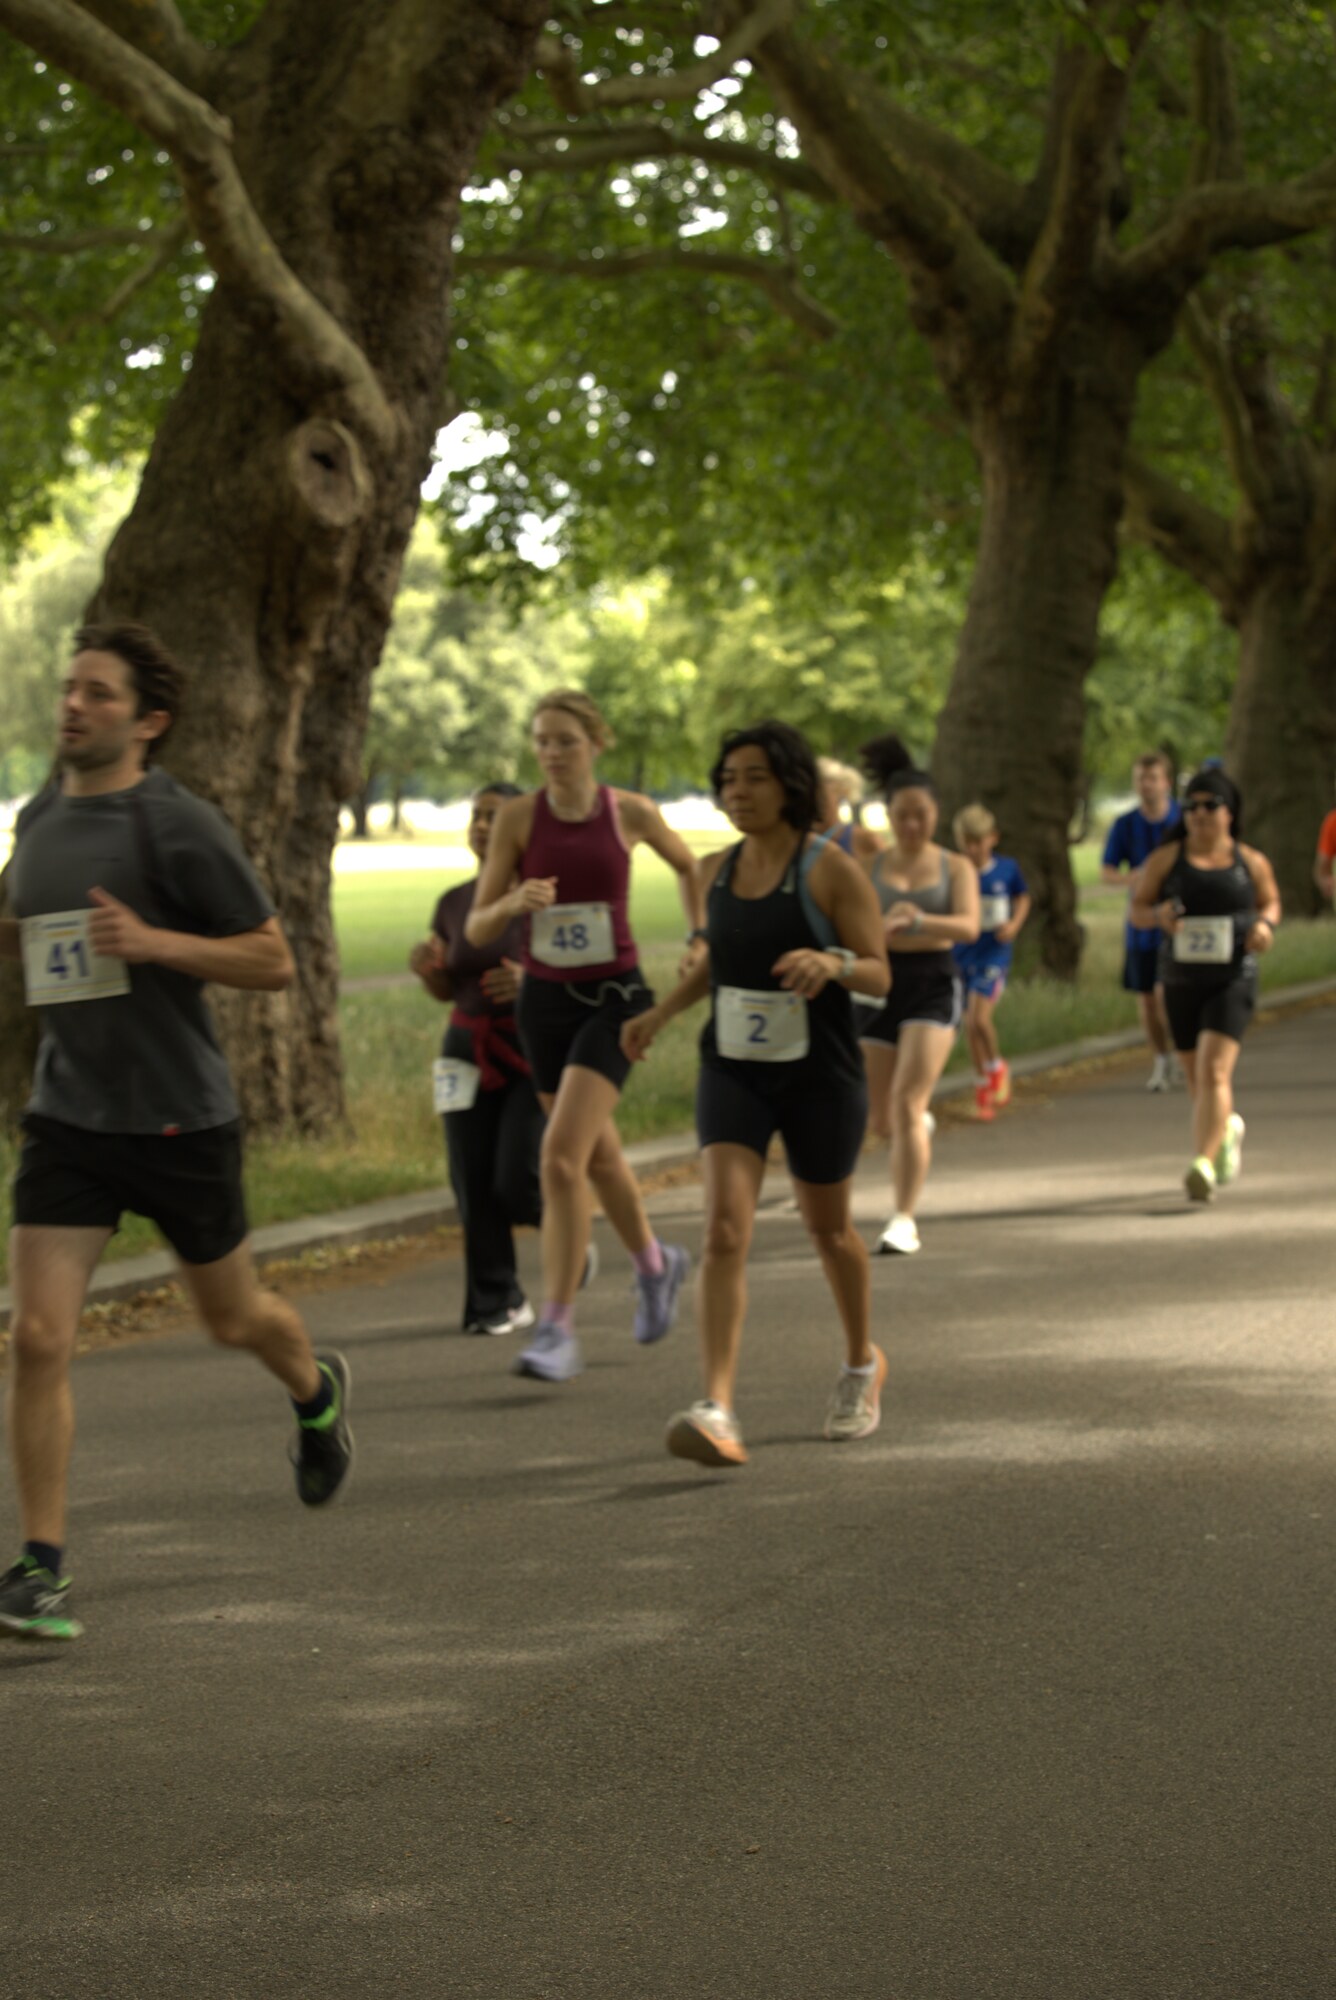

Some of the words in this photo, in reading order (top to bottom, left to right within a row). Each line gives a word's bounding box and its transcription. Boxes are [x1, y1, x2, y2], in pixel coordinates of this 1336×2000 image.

[551, 923, 590, 951] 48
[46, 939, 90, 980] 41
[746, 1013, 770, 1043] 2
